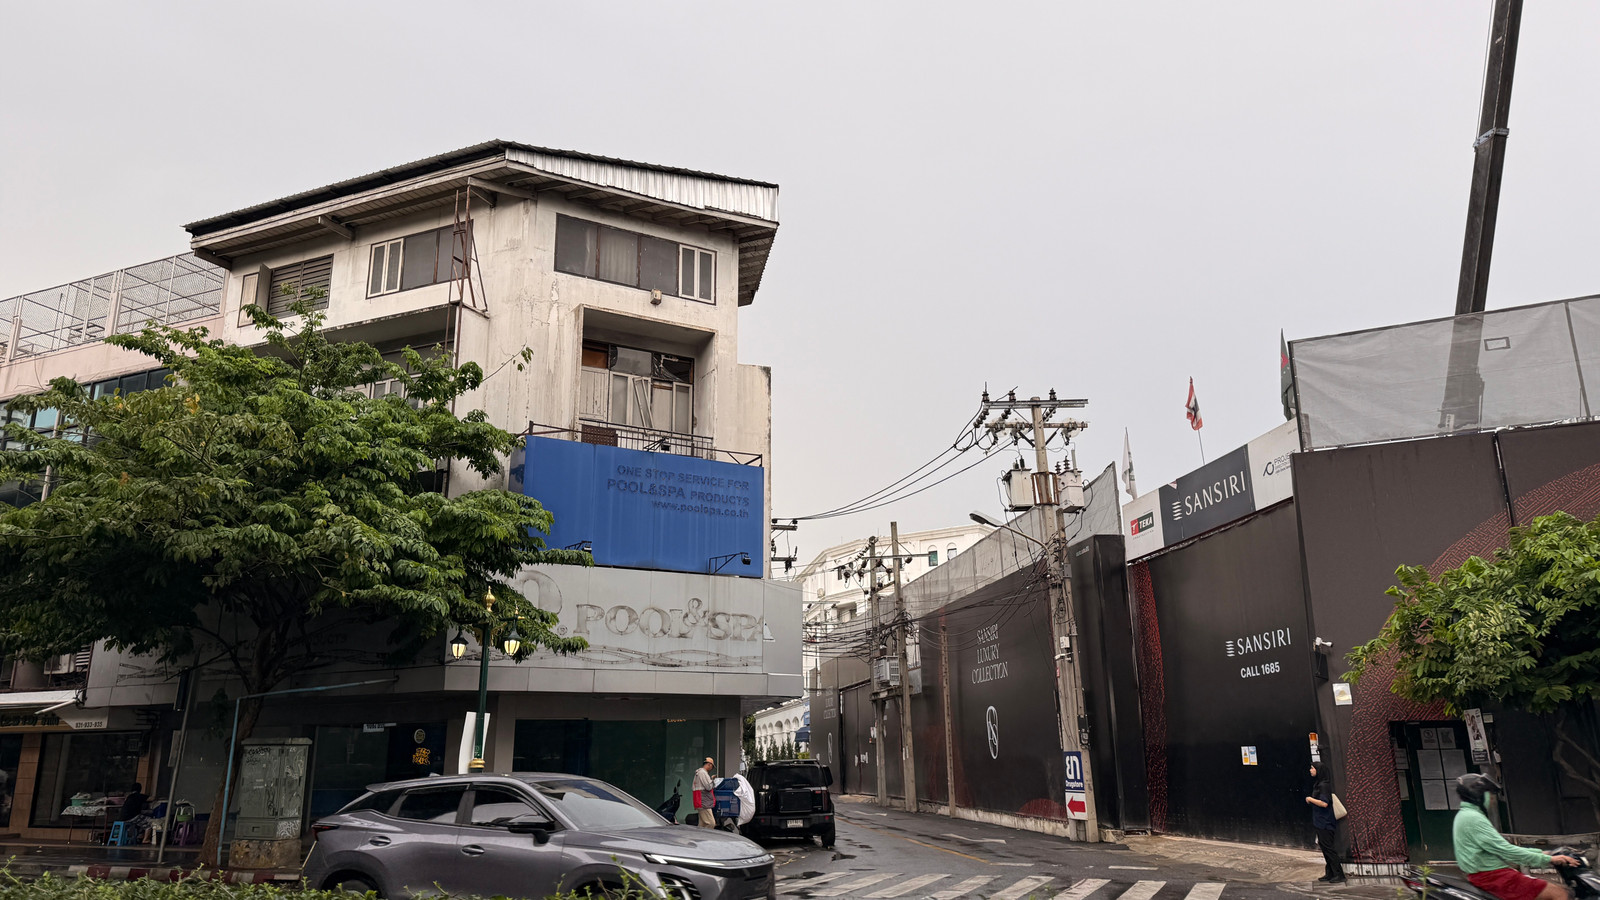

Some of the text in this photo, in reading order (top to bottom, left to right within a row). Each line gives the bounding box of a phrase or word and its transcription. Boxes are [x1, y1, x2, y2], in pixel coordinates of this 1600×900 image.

[1274, 448, 1296, 466] PROJE
[616, 464, 749, 490] ONE STOP SERVICE FOR
[607, 478, 750, 507] POOL&SPA PRODUCTS
[1185, 470, 1246, 516] SANSIRI
[651, 500, 749, 518] www.poolspa.co.th
[1139, 516, 1153, 529] TEKA
[1237, 627, 1292, 656] SANSIRI
[976, 643, 1000, 664] LUXURY
[971, 661, 1009, 685] COLLECTION
[1240, 661, 1280, 679] CALL 1685
[1065, 755, 1081, 780] ยา
[1065, 780, 1084, 789] Drugstore
